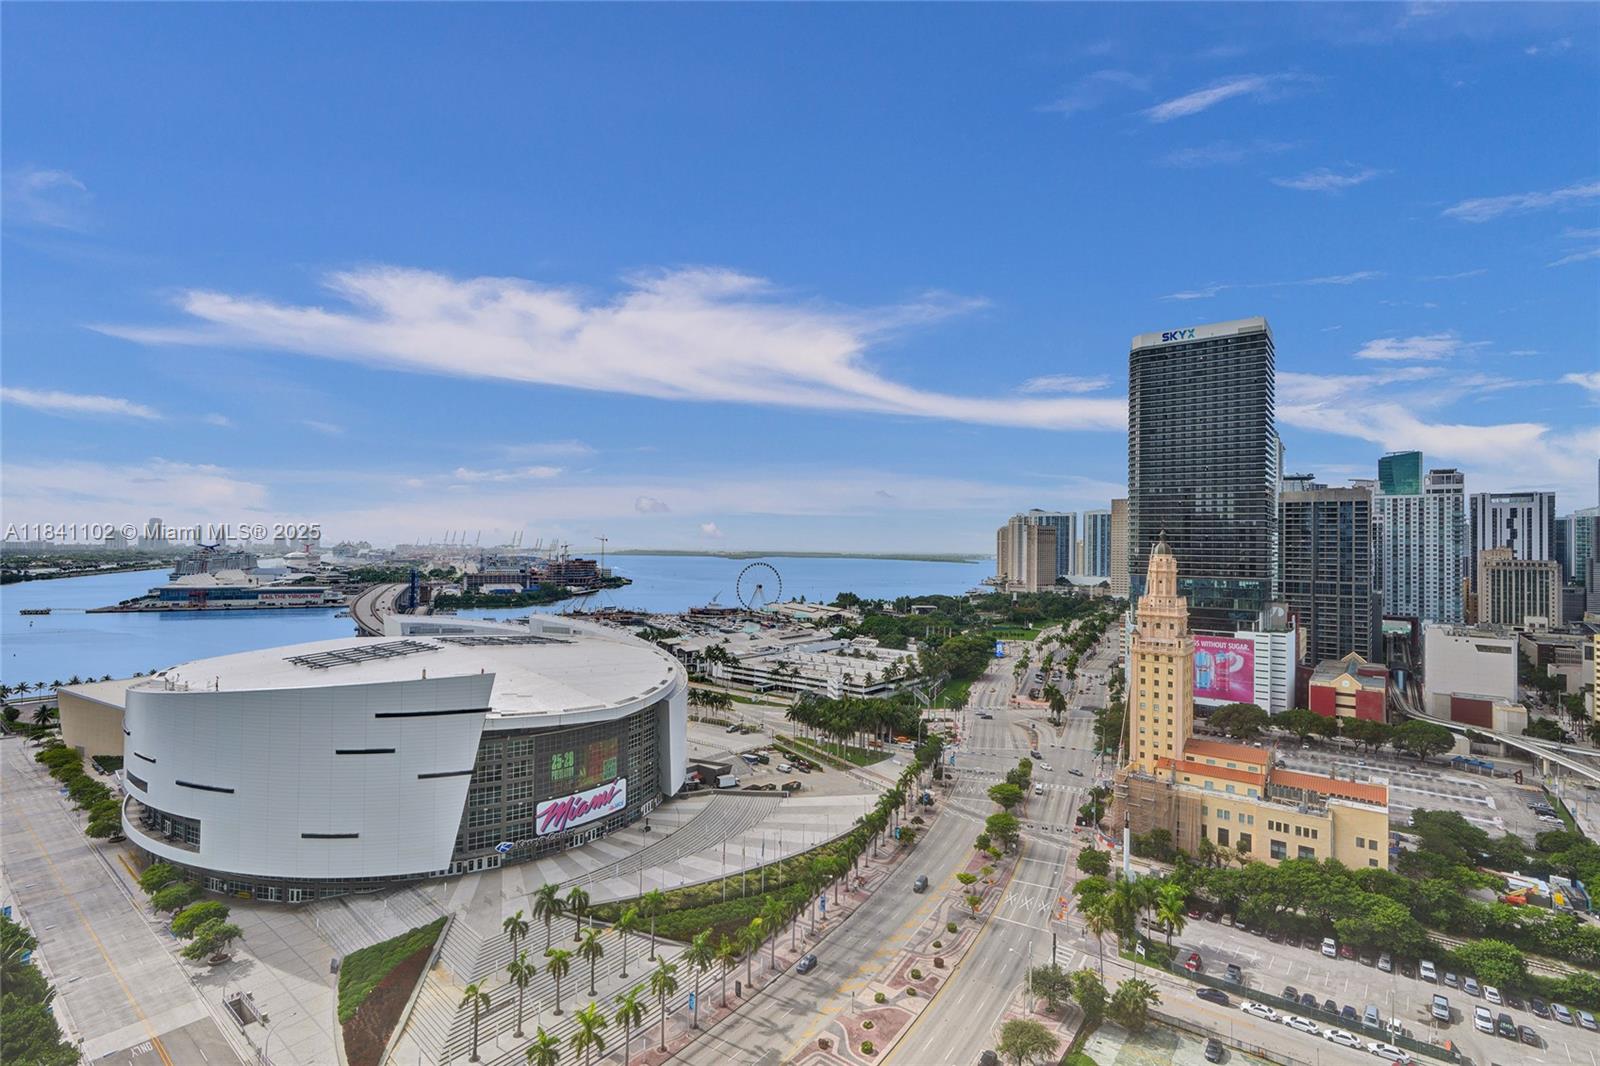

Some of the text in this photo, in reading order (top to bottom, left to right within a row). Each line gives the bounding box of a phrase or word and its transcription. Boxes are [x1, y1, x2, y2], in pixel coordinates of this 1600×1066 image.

[1162, 328, 1195, 342] SKYX
[1201, 640, 1227, 649] WITHOUT
[535, 778, 622, 832] Miami
[130, 1041, 153, 1058] ONLY
